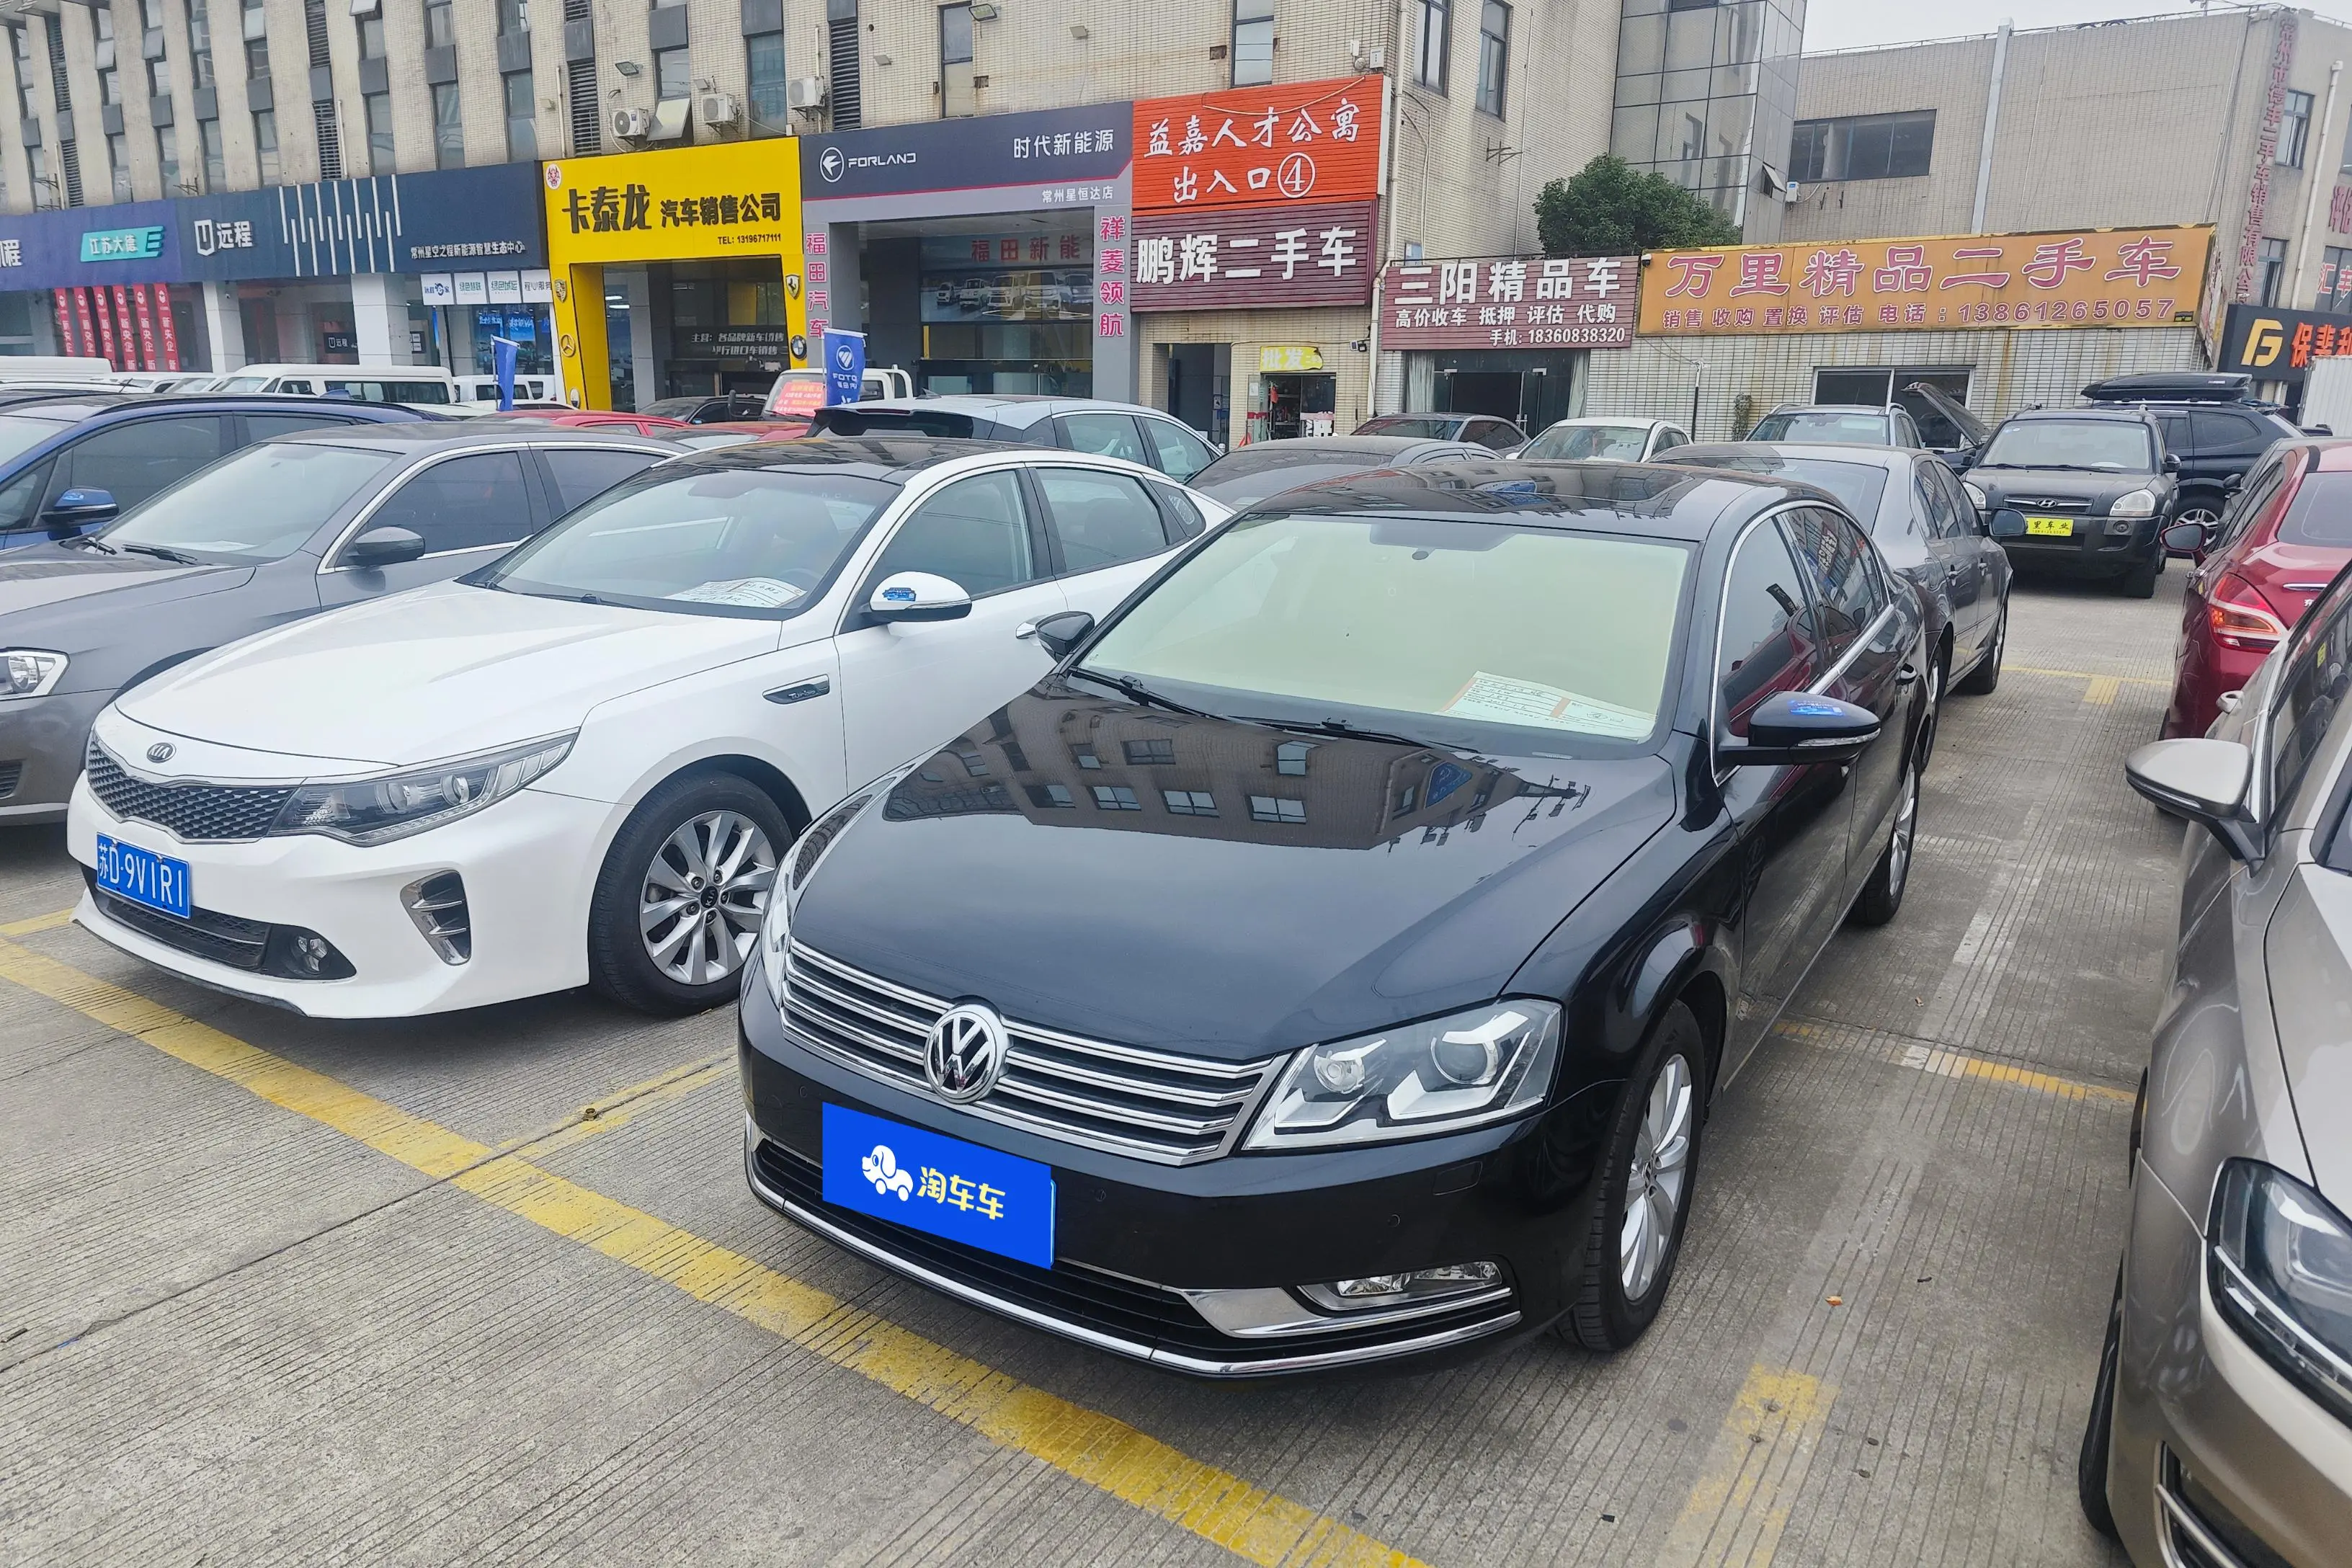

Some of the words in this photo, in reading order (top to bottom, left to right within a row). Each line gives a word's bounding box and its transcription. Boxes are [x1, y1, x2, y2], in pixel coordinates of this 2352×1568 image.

[1144, 97, 1360, 158] 益嘉人才公寓
[1013, 129, 1114, 159] 时代新能源
[848, 152, 917, 169] FORLAND
[562, 184, 652, 233] 卡泰龙
[660, 192, 781, 228] 汽车销售公司
[1042, 186, 1113, 204] 常州星恒达店
[216, 220, 253, 249] 远程
[718, 236, 734, 245] TEL:
[736, 233, 781, 244] 13196717111
[971, 234, 1094, 262] 福田新能
[1136, 226, 1357, 284] 鹏辉二手车
[1665, 235, 2183, 298] 万里精品二手车
[806, 232, 829, 339] 福田汽车
[1099, 215, 1126, 337] 祥菱领航
[1394, 257, 1621, 305] 三阳精品车
[1395, 307, 1467, 329] 高价收车
[1479, 306, 1515, 326] 抵押
[1526, 305, 1565, 326] 评估
[1577, 303, 1616, 324] 代购
[1662, 308, 1703, 329] 销售
[1711, 307, 1755, 328] 收购
[1763, 306, 1808, 327] 置换
[1819, 305, 1864, 325] 评估
[1958, 299, 2175, 324] 13861265057
[1528, 327, 1626, 344] 18360838320
[2026, 520, 2070, 531] 里车业
[150, 744, 171, 759] KIA
[705, 889, 716, 906] KIA
